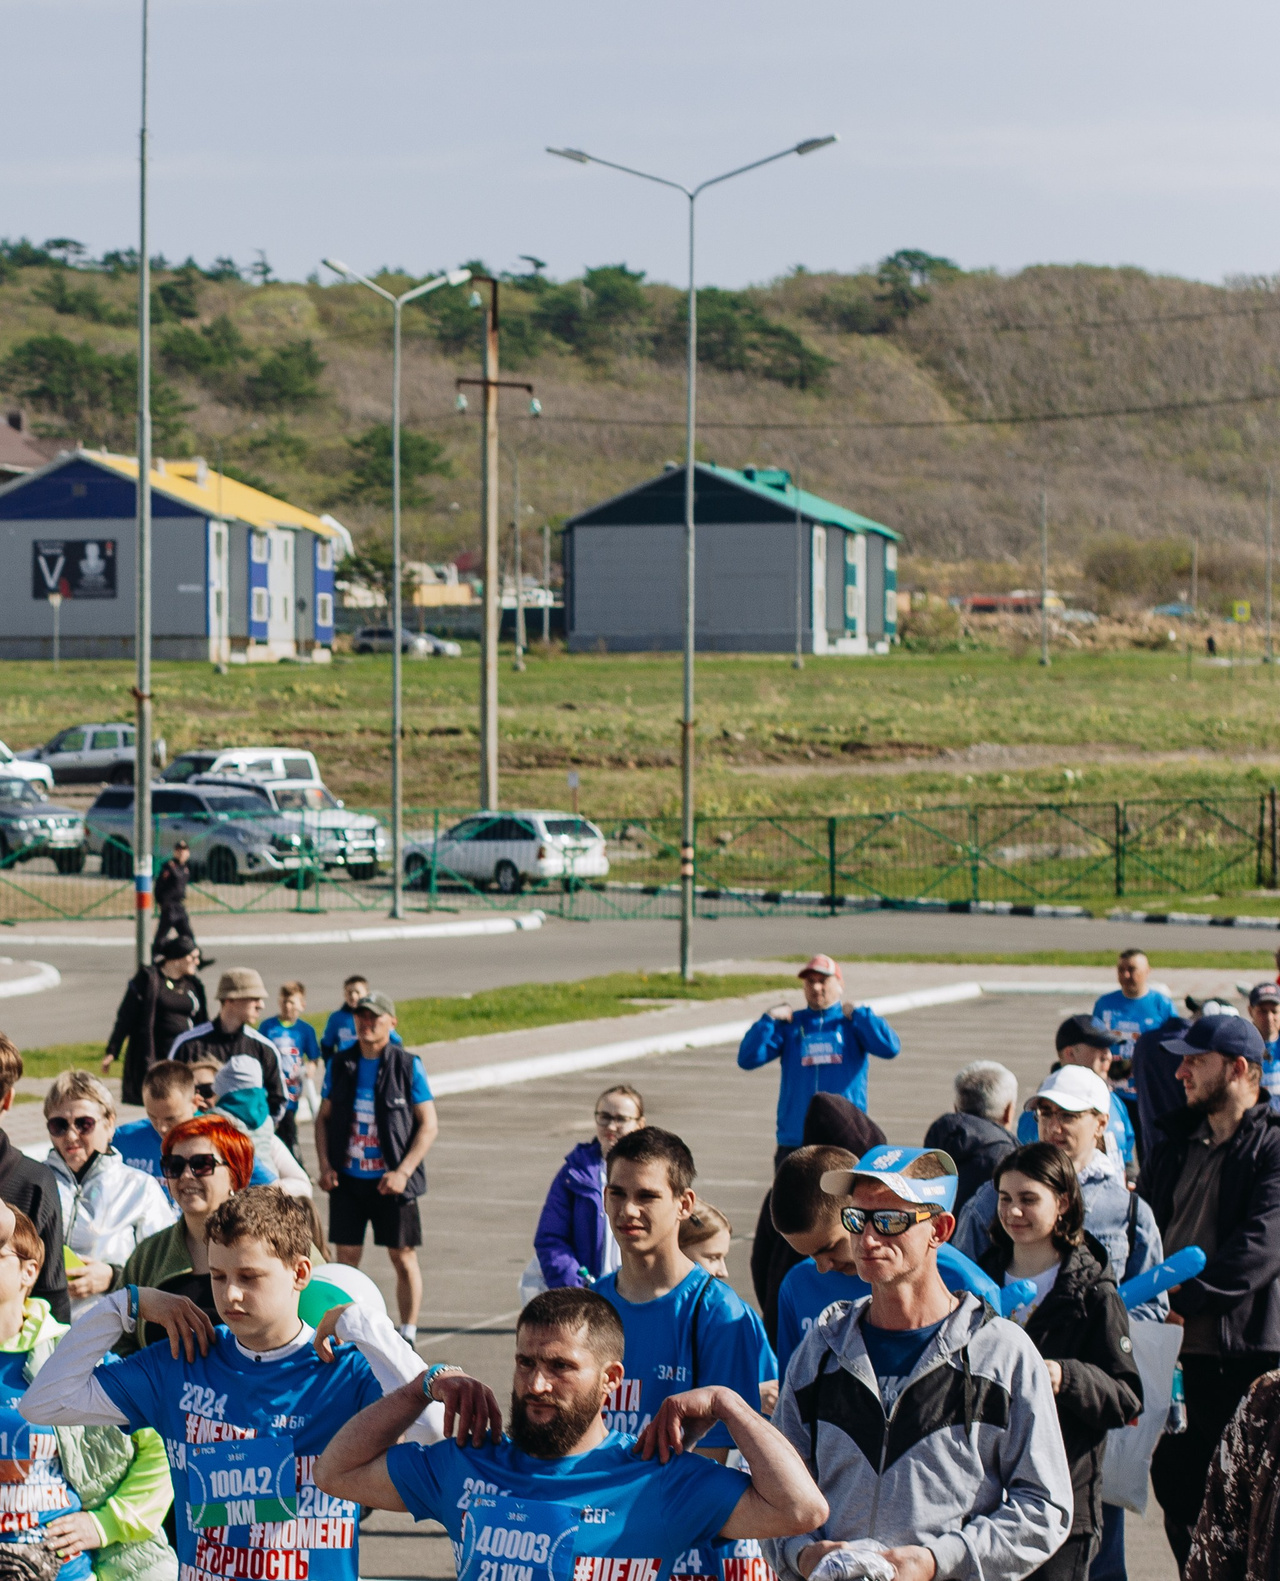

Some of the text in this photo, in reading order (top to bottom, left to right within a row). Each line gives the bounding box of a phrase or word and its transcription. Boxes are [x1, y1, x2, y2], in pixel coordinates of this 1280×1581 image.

[179, 1382, 228, 1420] 2024
[209, 1467, 273, 1498] 10042
[249, 1517, 355, 1549] #МОМЕНТ
[475, 1525, 551, 1564] 40003
